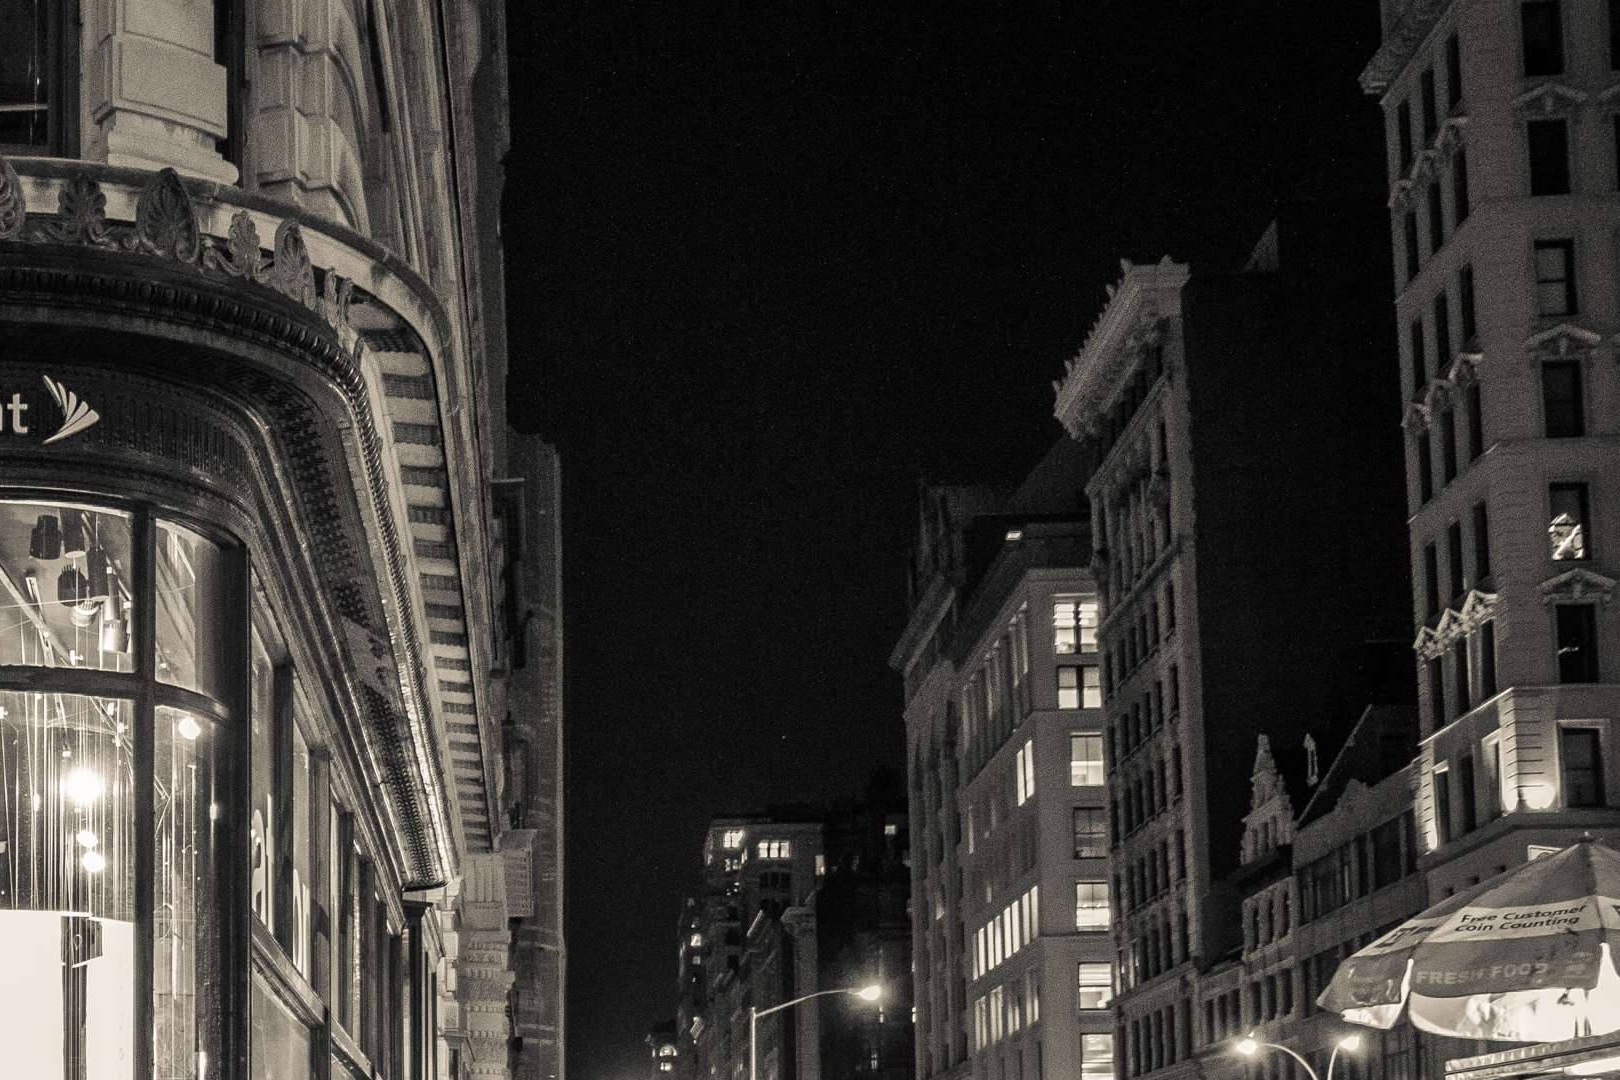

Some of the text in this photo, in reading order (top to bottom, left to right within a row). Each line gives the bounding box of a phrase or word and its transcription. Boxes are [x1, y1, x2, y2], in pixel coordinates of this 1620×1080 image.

[1460, 904, 1587, 924] Free Customer
[1499, 916, 1580, 930] Counting
